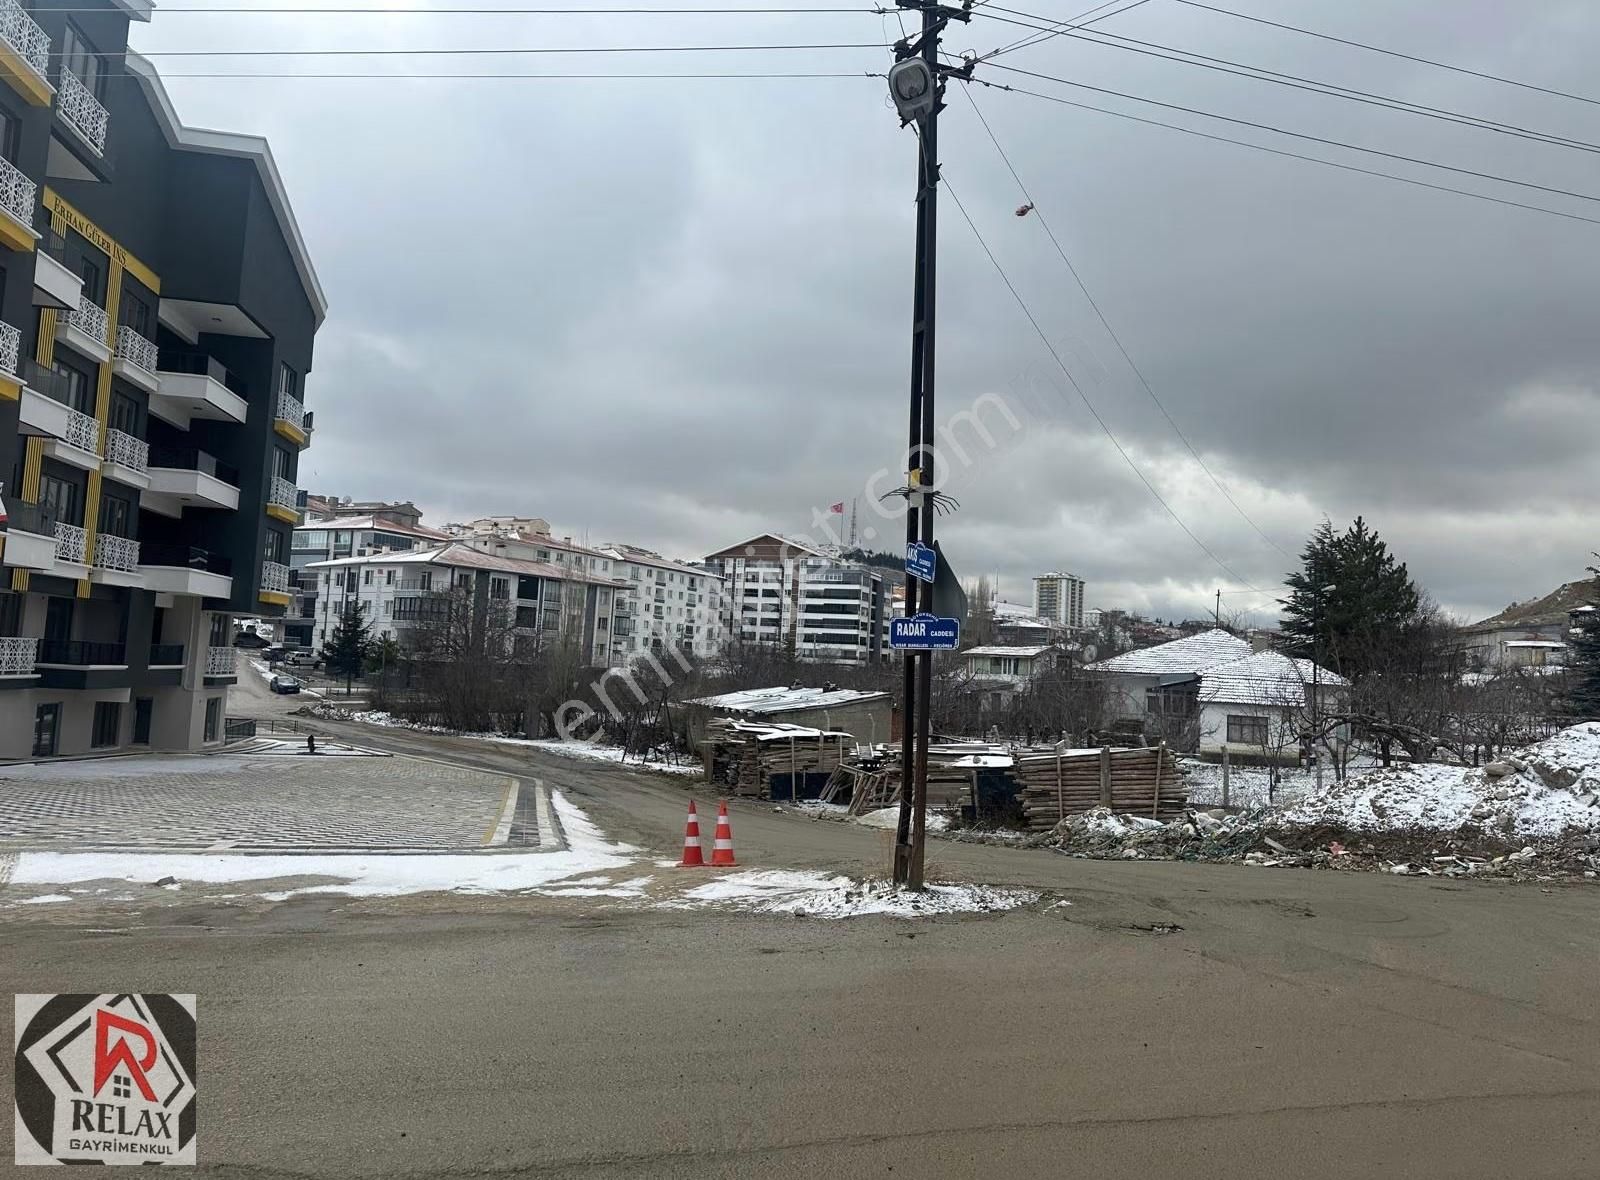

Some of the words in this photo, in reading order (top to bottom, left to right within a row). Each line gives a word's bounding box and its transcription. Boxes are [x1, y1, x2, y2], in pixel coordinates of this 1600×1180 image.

[54, 196, 84, 232] ERHAN
[85, 223, 110, 253] GÜLER
[896, 623, 926, 636] RADAR
